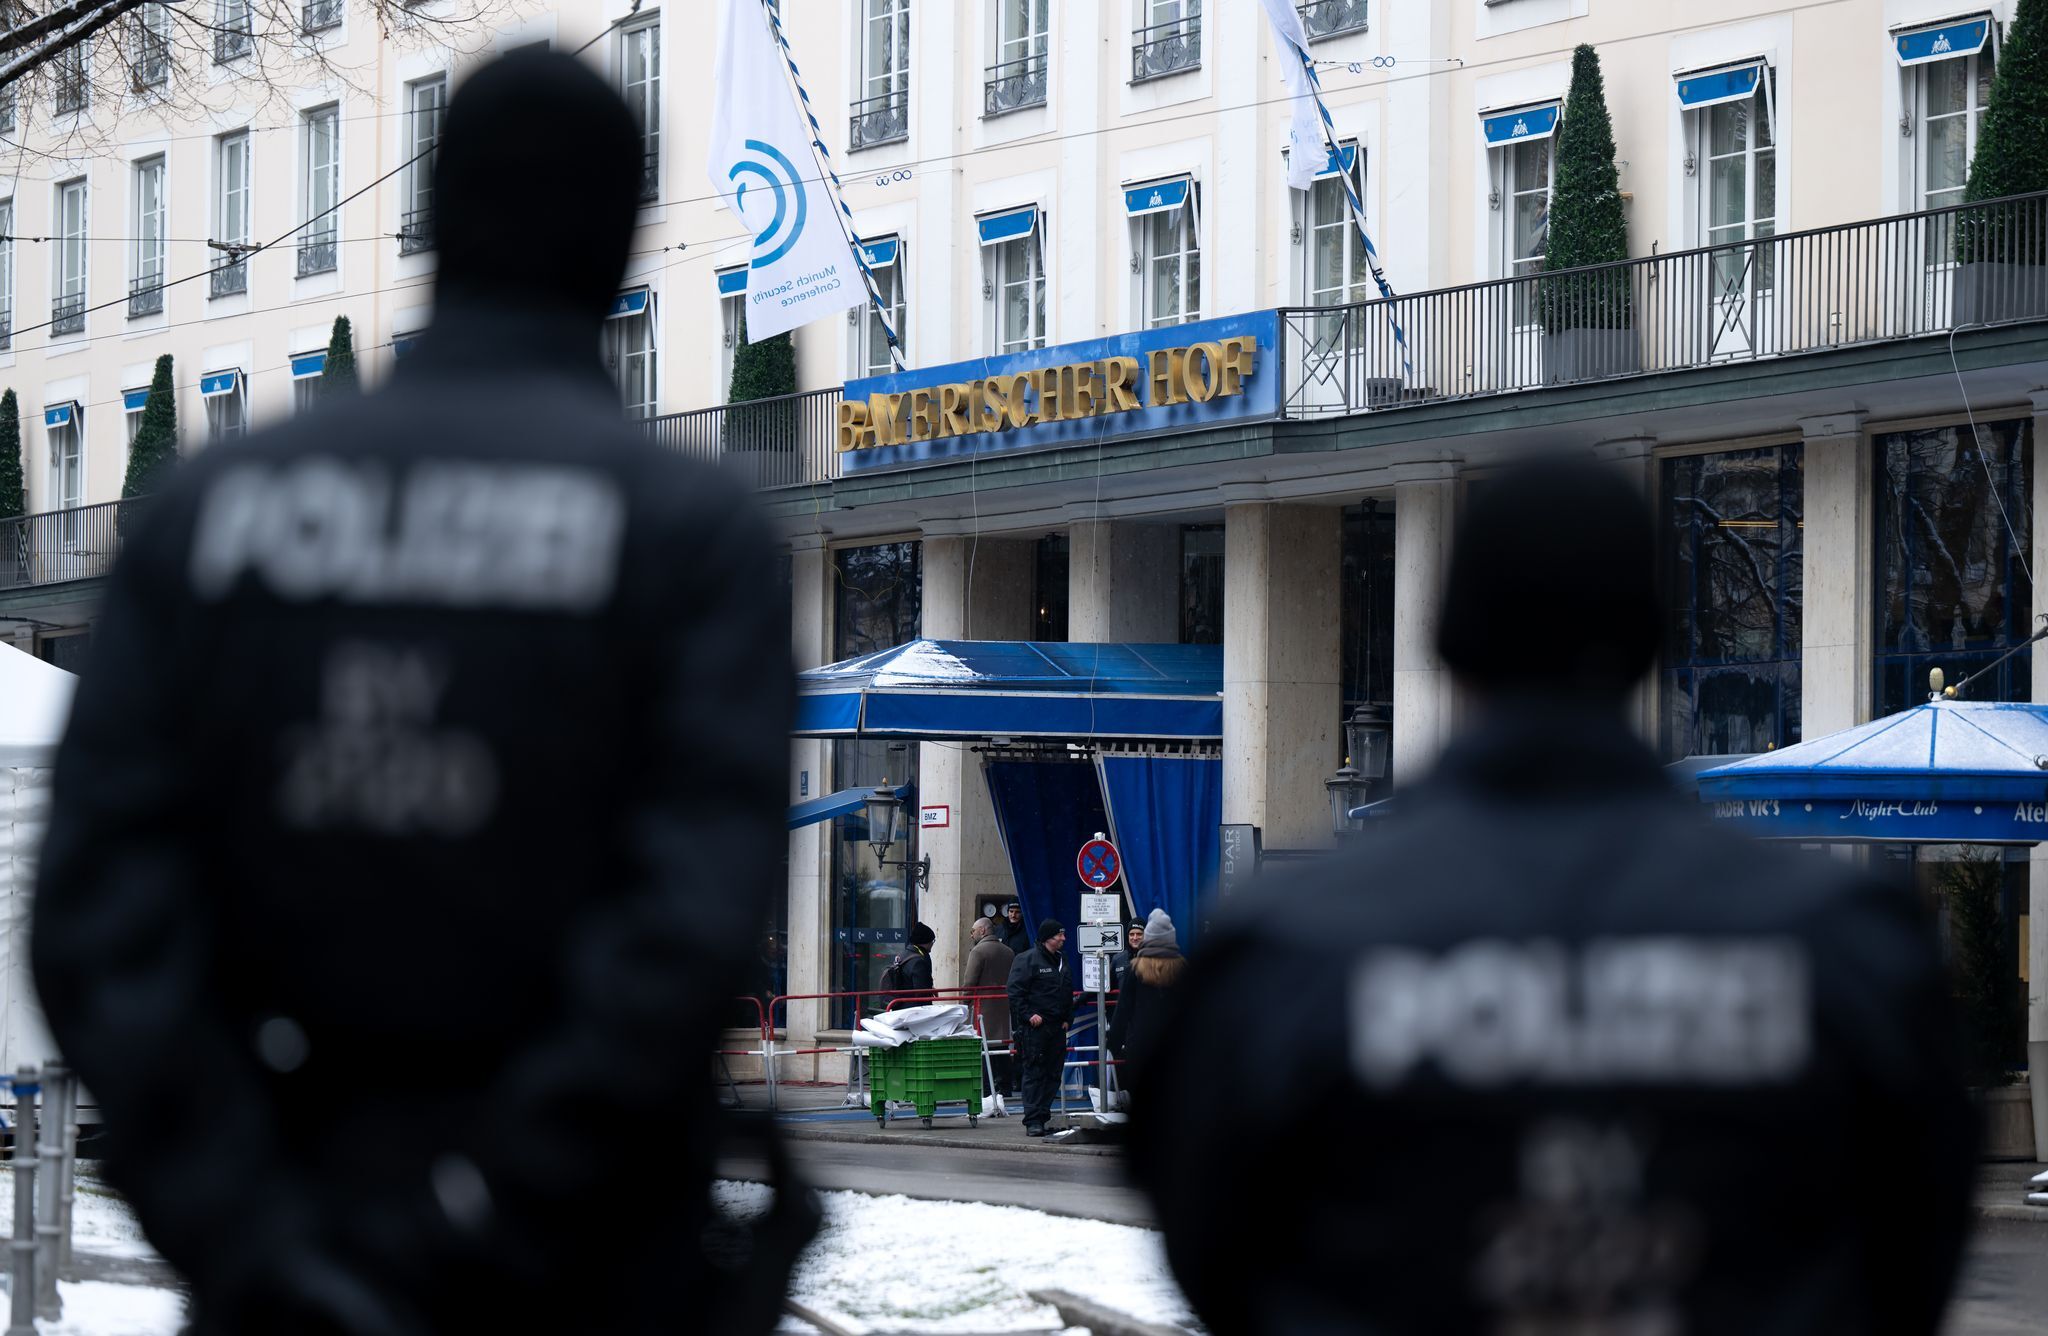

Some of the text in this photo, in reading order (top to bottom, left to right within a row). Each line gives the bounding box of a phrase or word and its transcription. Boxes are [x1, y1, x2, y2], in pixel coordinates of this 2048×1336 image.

[835, 335, 1256, 453] BAYERISCHER HOF
[924, 812, 937, 821] BMZ
[1749, 799, 1780, 816] VIC'S
[1224, 829, 1234, 874] BAR
